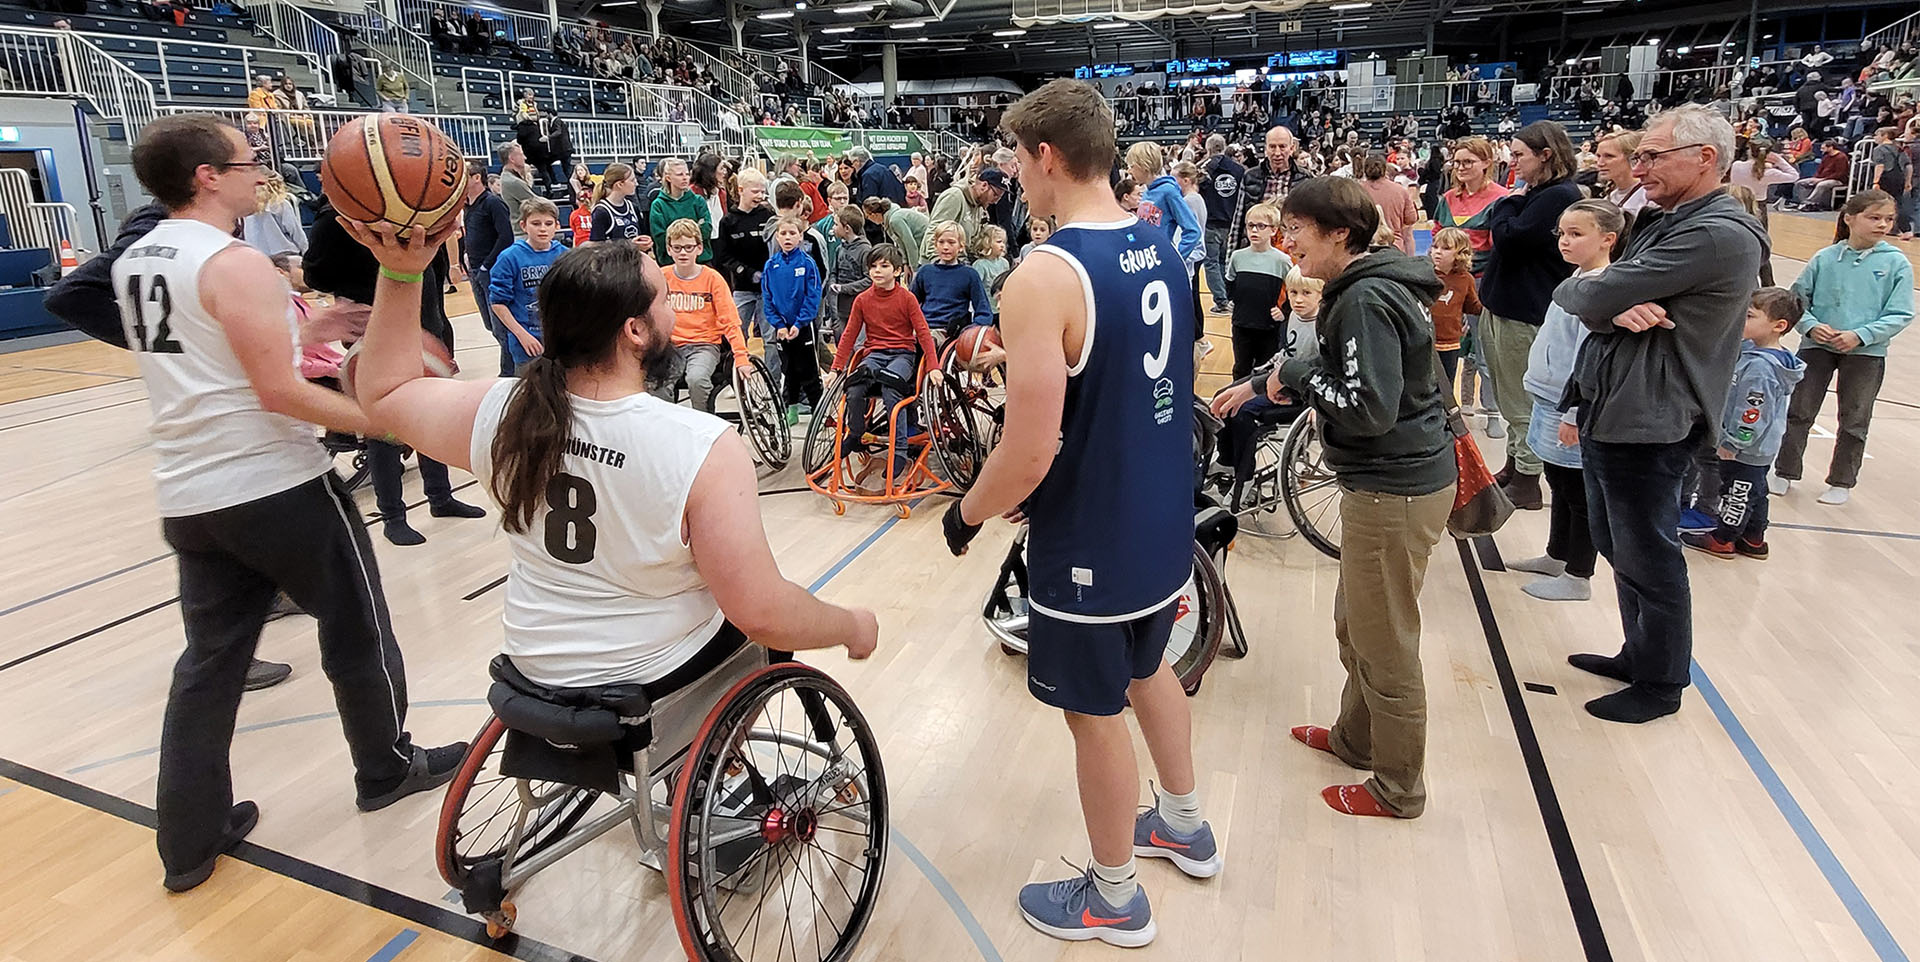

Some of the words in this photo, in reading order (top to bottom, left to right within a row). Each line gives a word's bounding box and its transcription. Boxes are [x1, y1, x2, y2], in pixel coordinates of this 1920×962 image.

[1286, 21, 1294, 31] H
[521, 265, 549, 280] BRK
[1119, 244, 1162, 274] GRUBE
[1141, 280, 1172, 380] 9
[544, 472, 597, 564] 8
